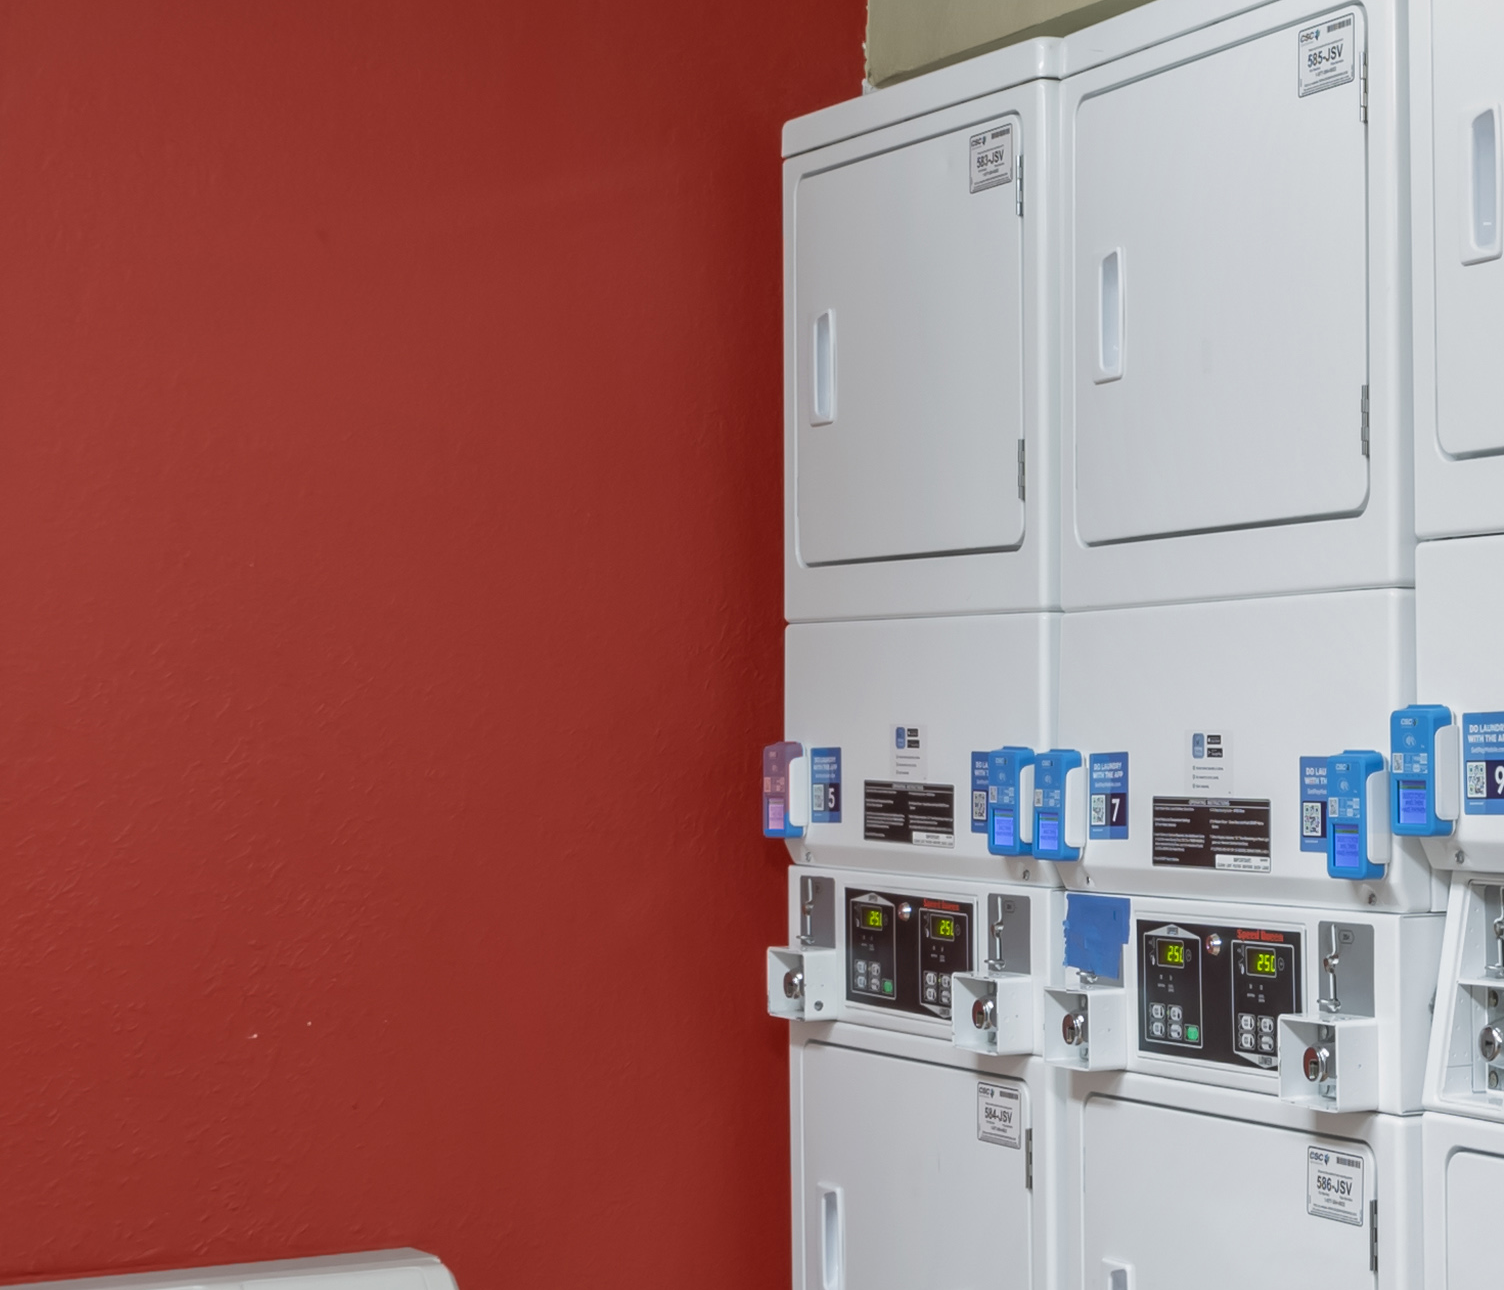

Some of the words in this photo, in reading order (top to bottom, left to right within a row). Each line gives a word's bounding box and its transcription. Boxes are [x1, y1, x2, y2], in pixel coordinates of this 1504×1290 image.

[1469, 725, 1478, 733] DO
[1468, 735, 1484, 743] WITH
[828, 788, 835, 809] 5
[1111, 798, 1121, 822] 7
[1317, 1176, 1352, 1195] 586-JSV
